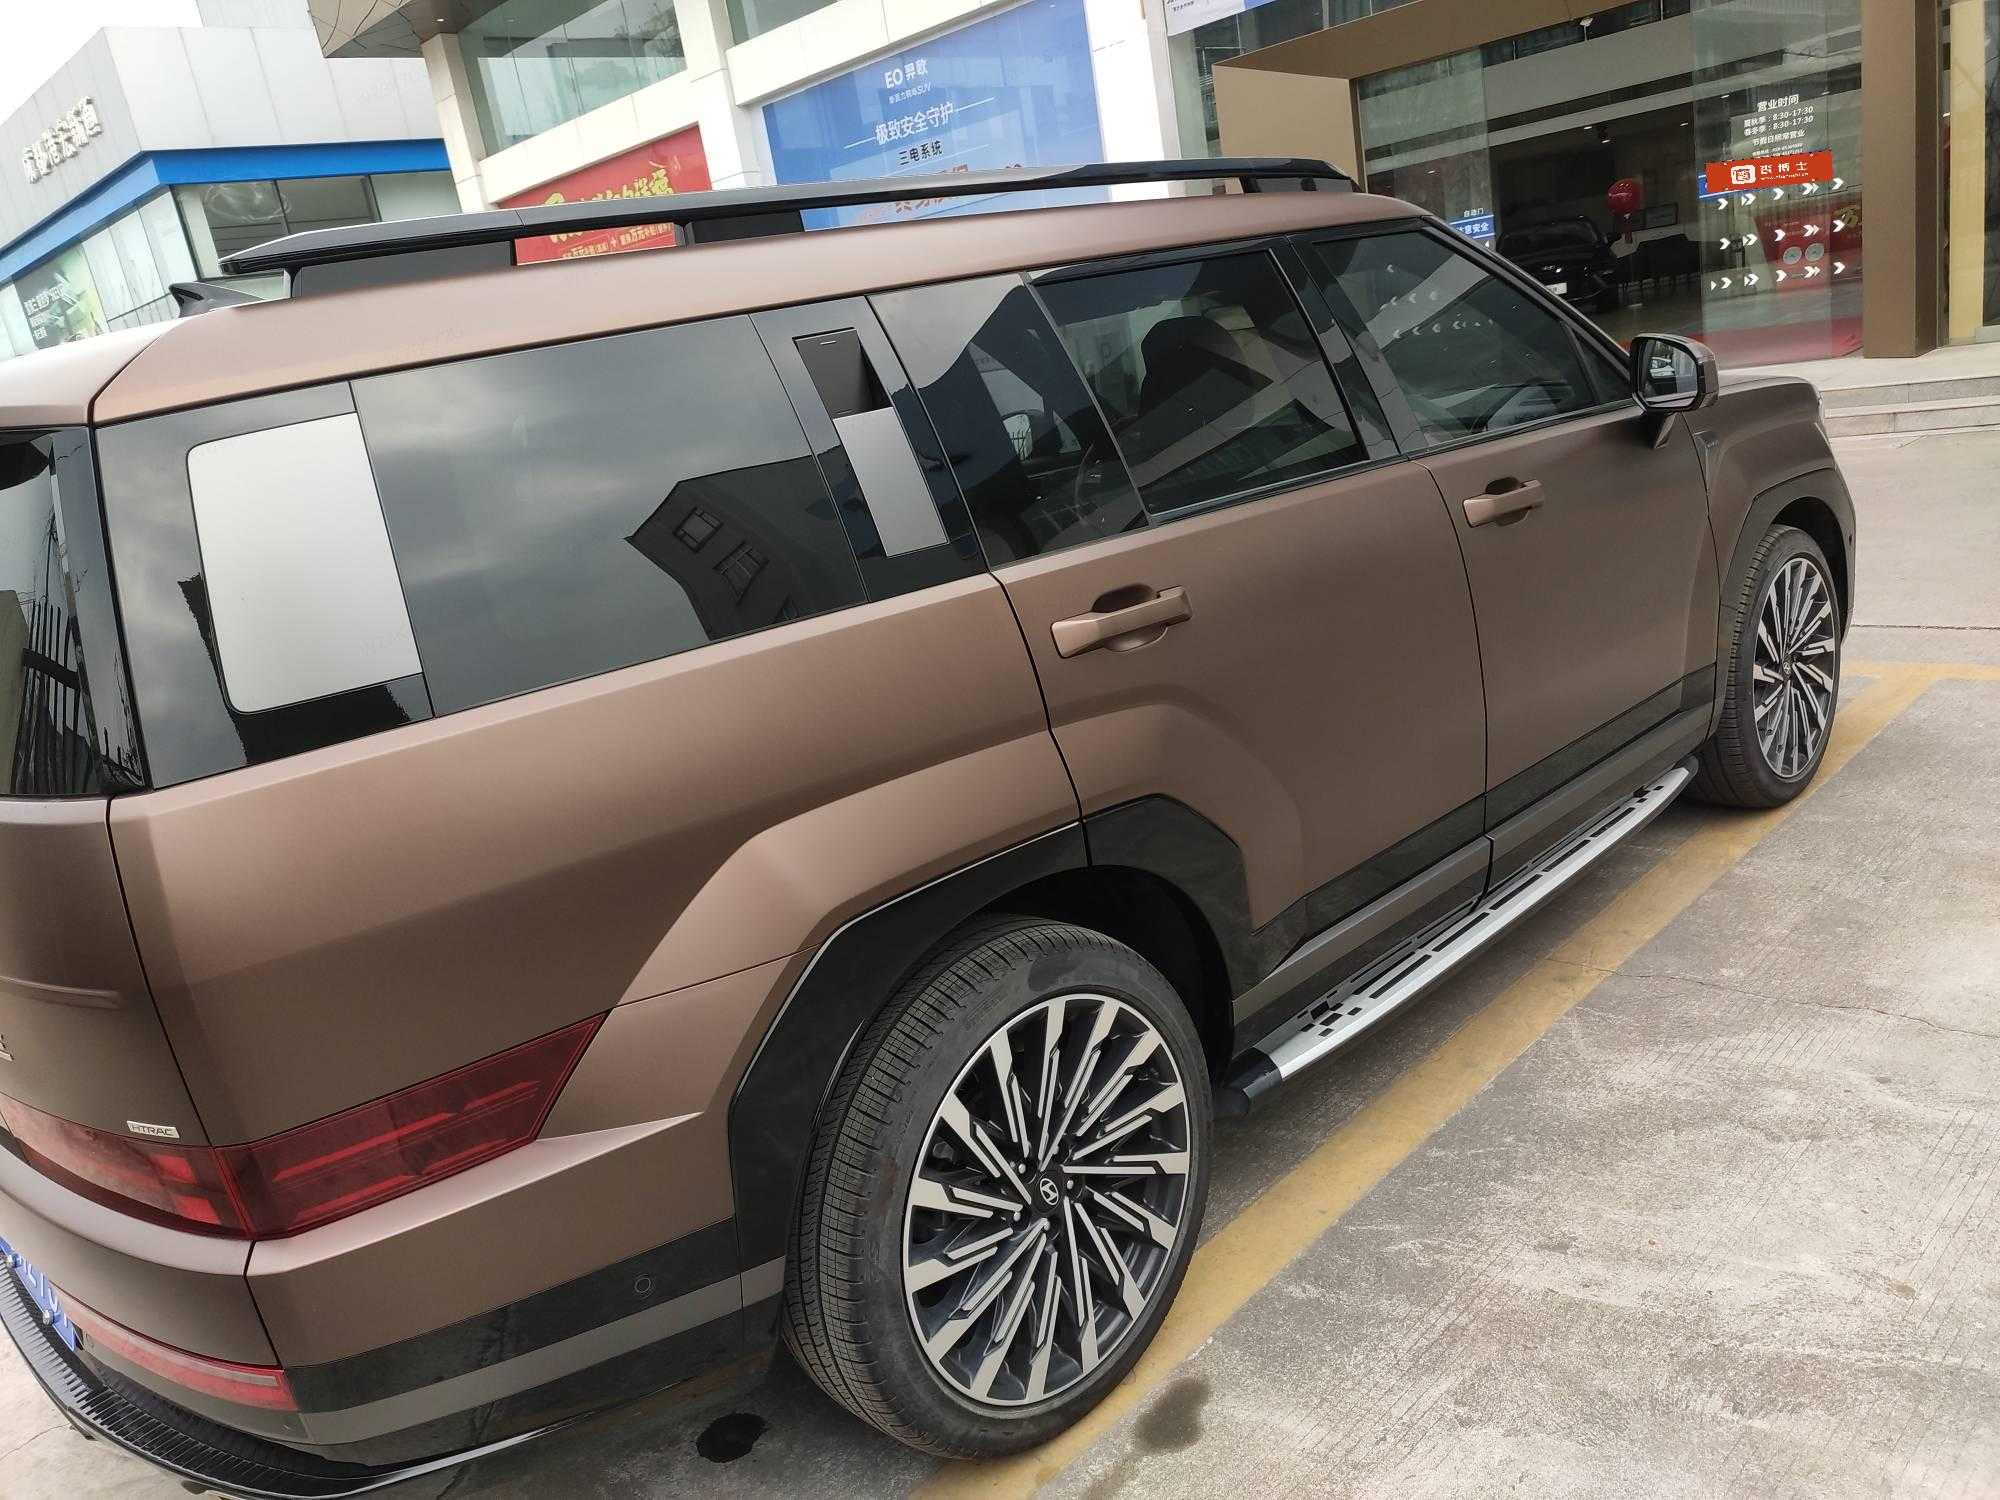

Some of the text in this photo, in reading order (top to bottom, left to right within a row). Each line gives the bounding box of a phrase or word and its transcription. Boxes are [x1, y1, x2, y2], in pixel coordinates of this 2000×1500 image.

[884, 68, 903, 88] EO
[1757, 94, 1799, 112] 营业时间
[875, 101, 954, 145] 极致安全守护
[898, 140, 943, 165] 三电系统
[130, 1122, 177, 1138] HTRAC
